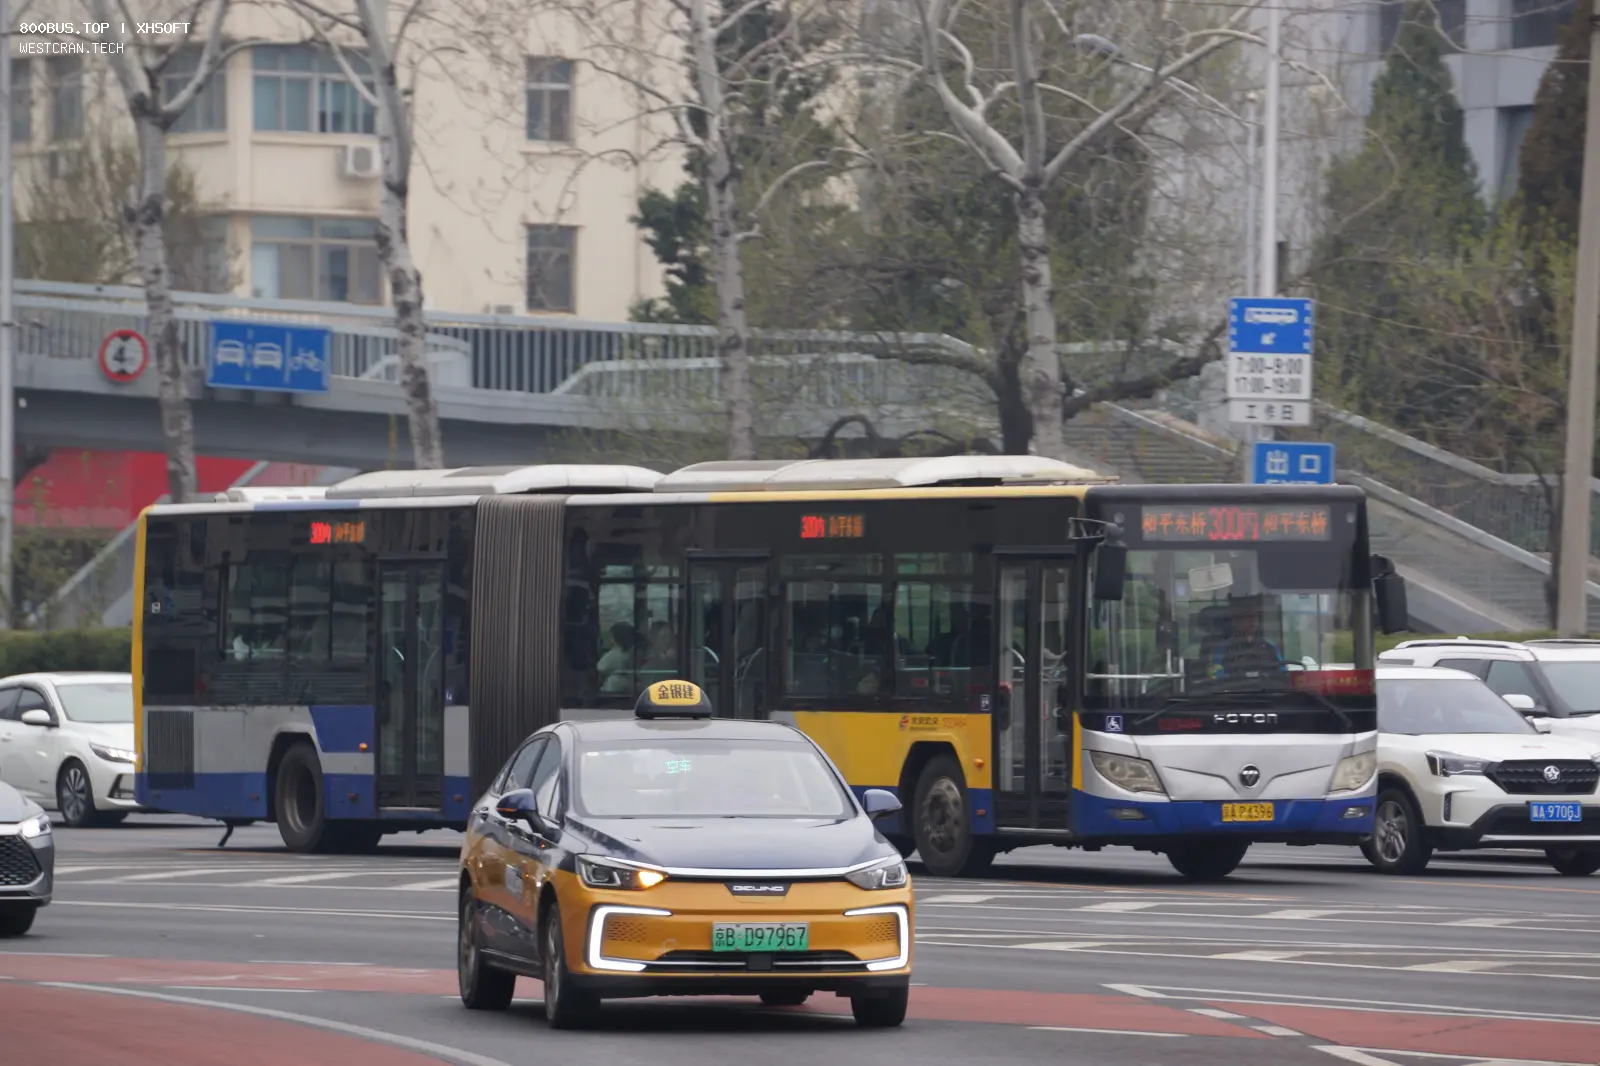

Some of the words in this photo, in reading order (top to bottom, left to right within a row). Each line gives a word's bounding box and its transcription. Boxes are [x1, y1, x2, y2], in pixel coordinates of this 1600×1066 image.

[1245, 403, 1295, 421] 工作日
[1265, 449, 1321, 476] 出口
[658, 684, 695, 700] 金银建
[1213, 712, 1278, 724] FOTON
